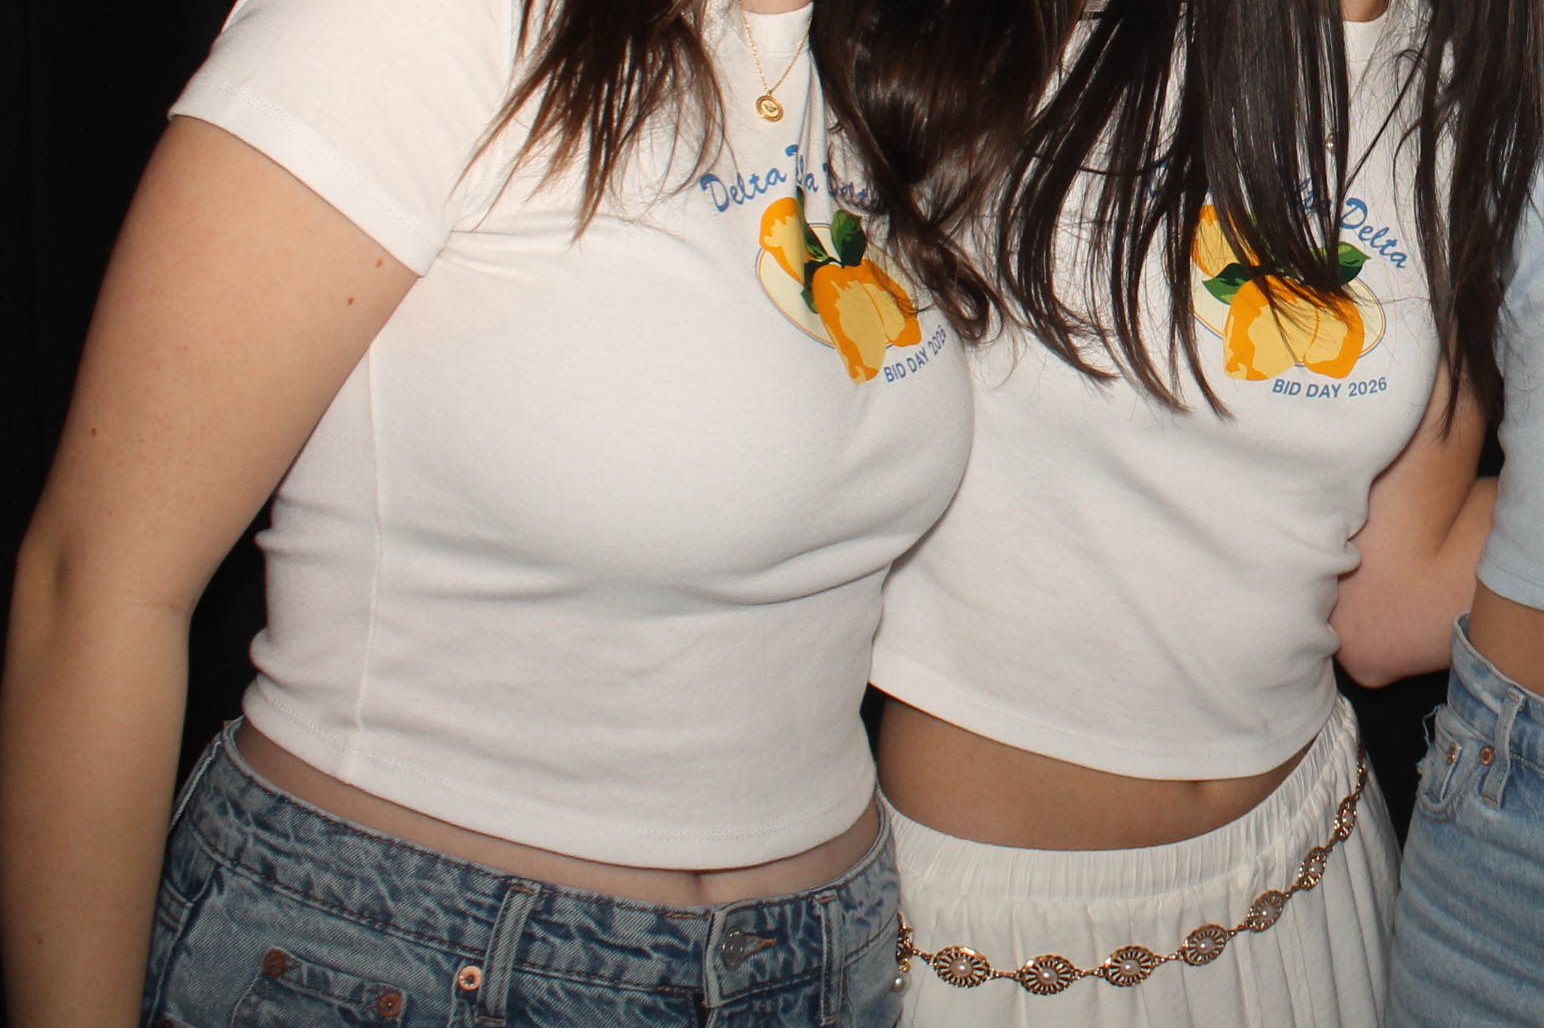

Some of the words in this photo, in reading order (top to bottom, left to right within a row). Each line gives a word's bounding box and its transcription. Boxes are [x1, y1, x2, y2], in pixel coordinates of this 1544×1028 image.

[700, 167, 787, 213] Delta
[1340, 197, 1408, 269] Delta
[883, 363, 907, 383] BID
[906, 347, 930, 374] DAY
[1272, 378, 1302, 396] BID
[1305, 383, 1342, 398] DAY
[1347, 376, 1387, 397] 2026
